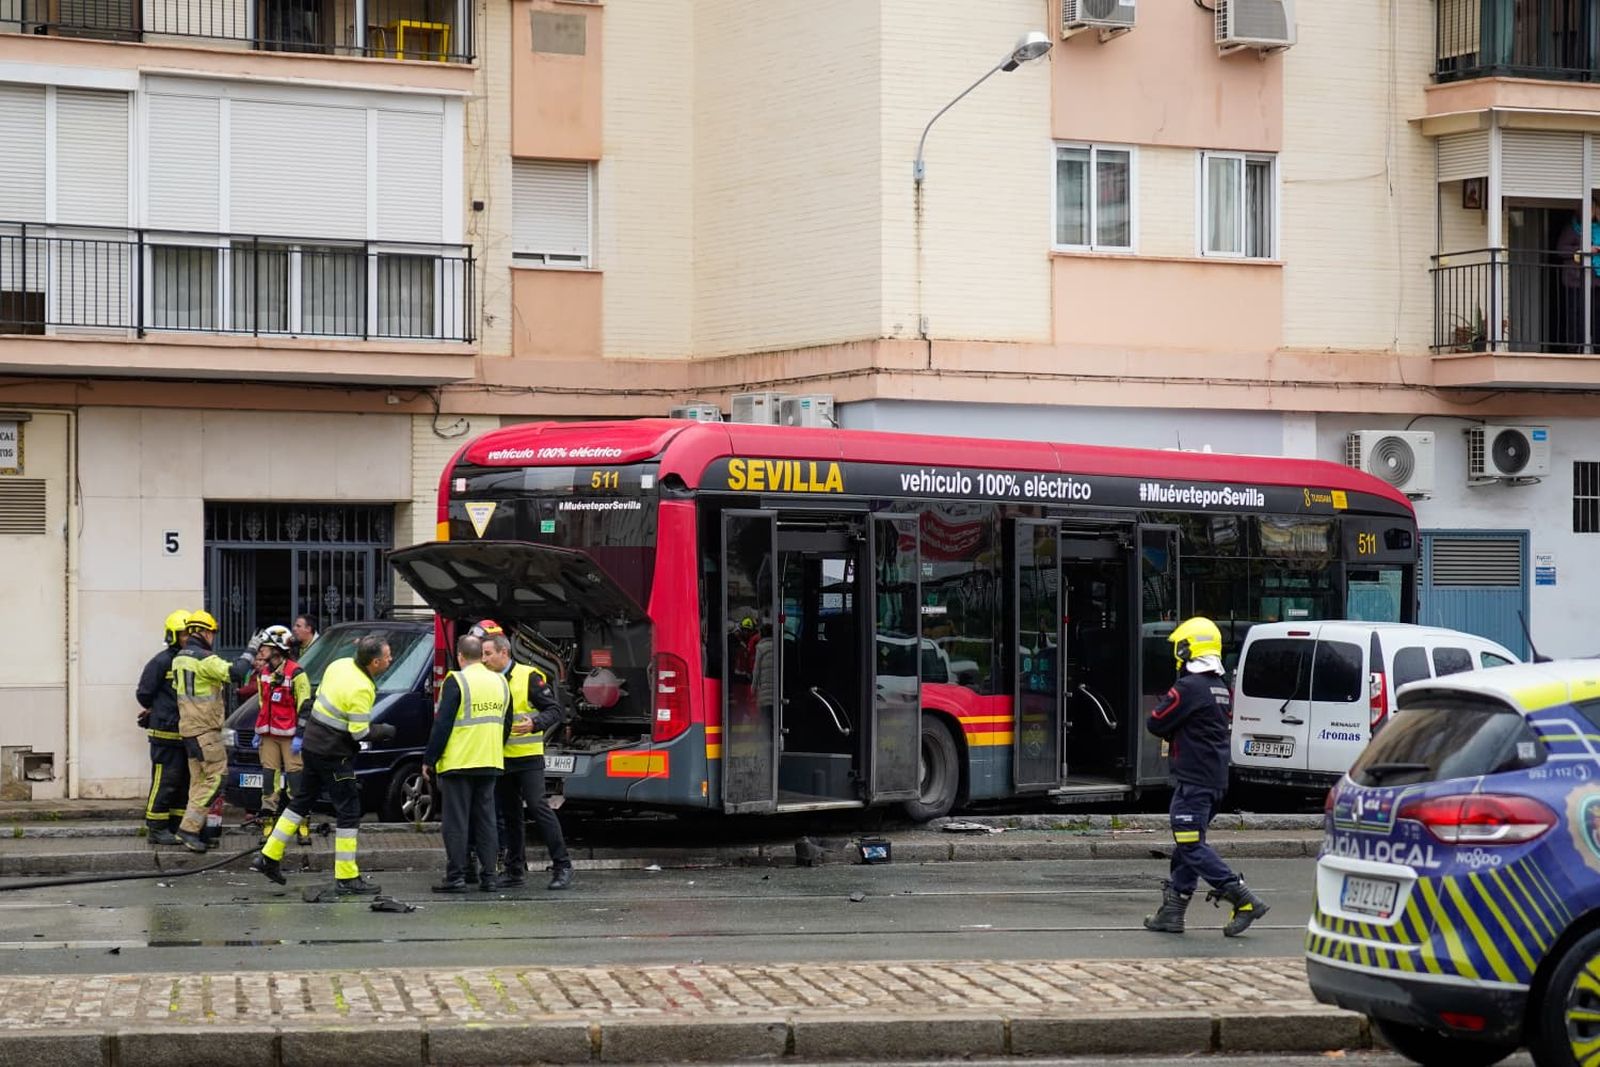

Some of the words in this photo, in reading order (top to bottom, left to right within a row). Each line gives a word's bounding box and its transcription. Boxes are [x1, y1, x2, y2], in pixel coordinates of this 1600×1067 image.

[488, 448, 534, 460] vehículo
[537, 447, 566, 458] 100%
[569, 446, 622, 458] eléctrico
[591, 470, 619, 489] 511
[727, 458, 844, 493] SEVILLA
[900, 469, 972, 495] vehículo
[976, 474, 1020, 497] 100%
[1024, 476, 1092, 500] eléctrico
[559, 501, 641, 511] #MuéveteporSevilla
[1139, 483, 1265, 508] #MuéveteporSevilla
[165, 531, 179, 553] 5
[1358, 533, 1376, 554] 511
[1318, 729, 1361, 741] Aromas
[554, 757, 571, 769] MHR
[1365, 839, 1442, 868] LOCAL
